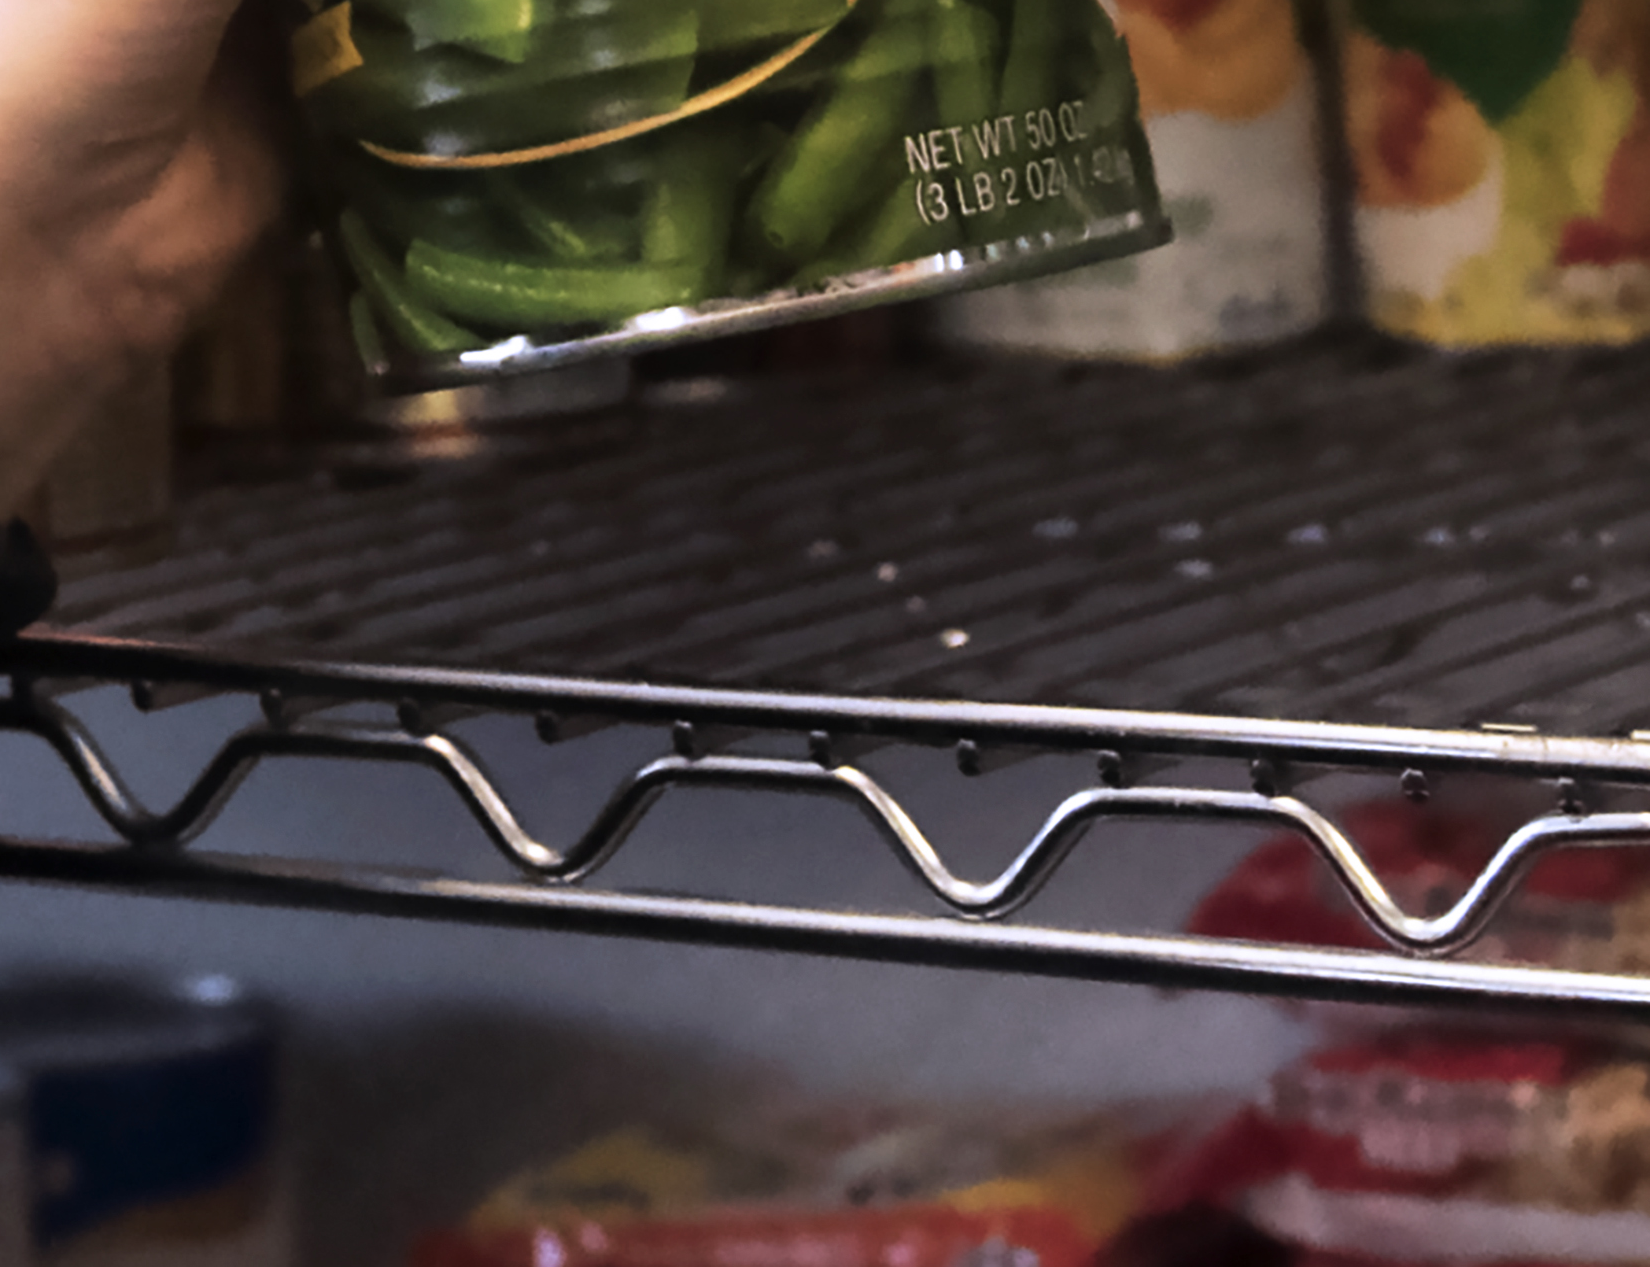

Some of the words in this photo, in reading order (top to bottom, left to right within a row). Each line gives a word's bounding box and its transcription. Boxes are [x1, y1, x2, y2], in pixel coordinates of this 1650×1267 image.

[905, 125, 963, 174] NET
[972, 115, 1017, 160] WT
[1025, 108, 1056, 150] 50
[1058, 100, 1089, 142] OZ
[915, 179, 949, 226] (3
[955, 171, 996, 216] LB
[1001, 167, 1021, 206] 2
